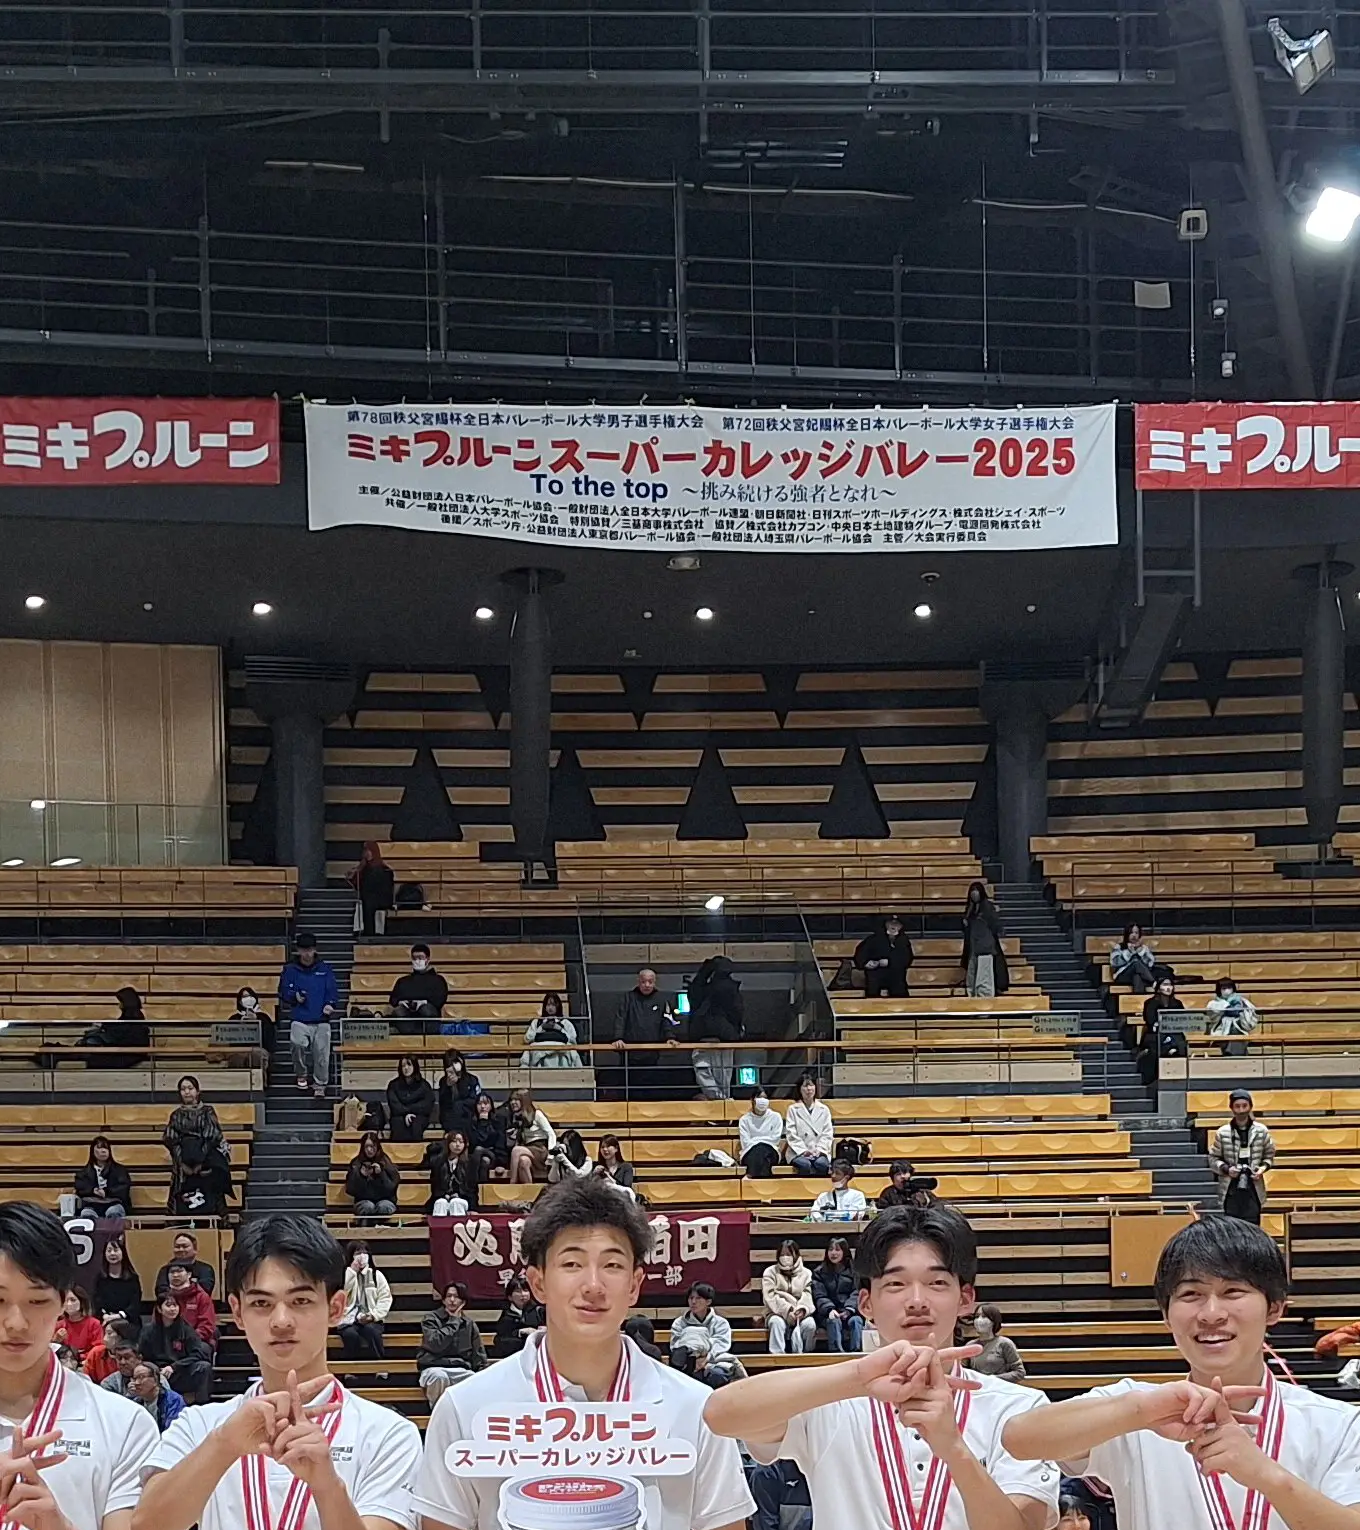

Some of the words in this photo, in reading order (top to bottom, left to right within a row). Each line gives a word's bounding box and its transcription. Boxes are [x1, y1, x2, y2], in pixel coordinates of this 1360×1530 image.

[2, 410, 269, 470] ミキプルーン
[347, 429, 1076, 480] ミキプルーンスーパーカレッジバレー2025
[529, 473, 564, 496] To
[573, 475, 615, 498] the
[623, 478, 668, 502] top
[487, 1407, 657, 1443] ミキプルーン
[454, 1446, 690, 1468] スーパーカレッジバレー
